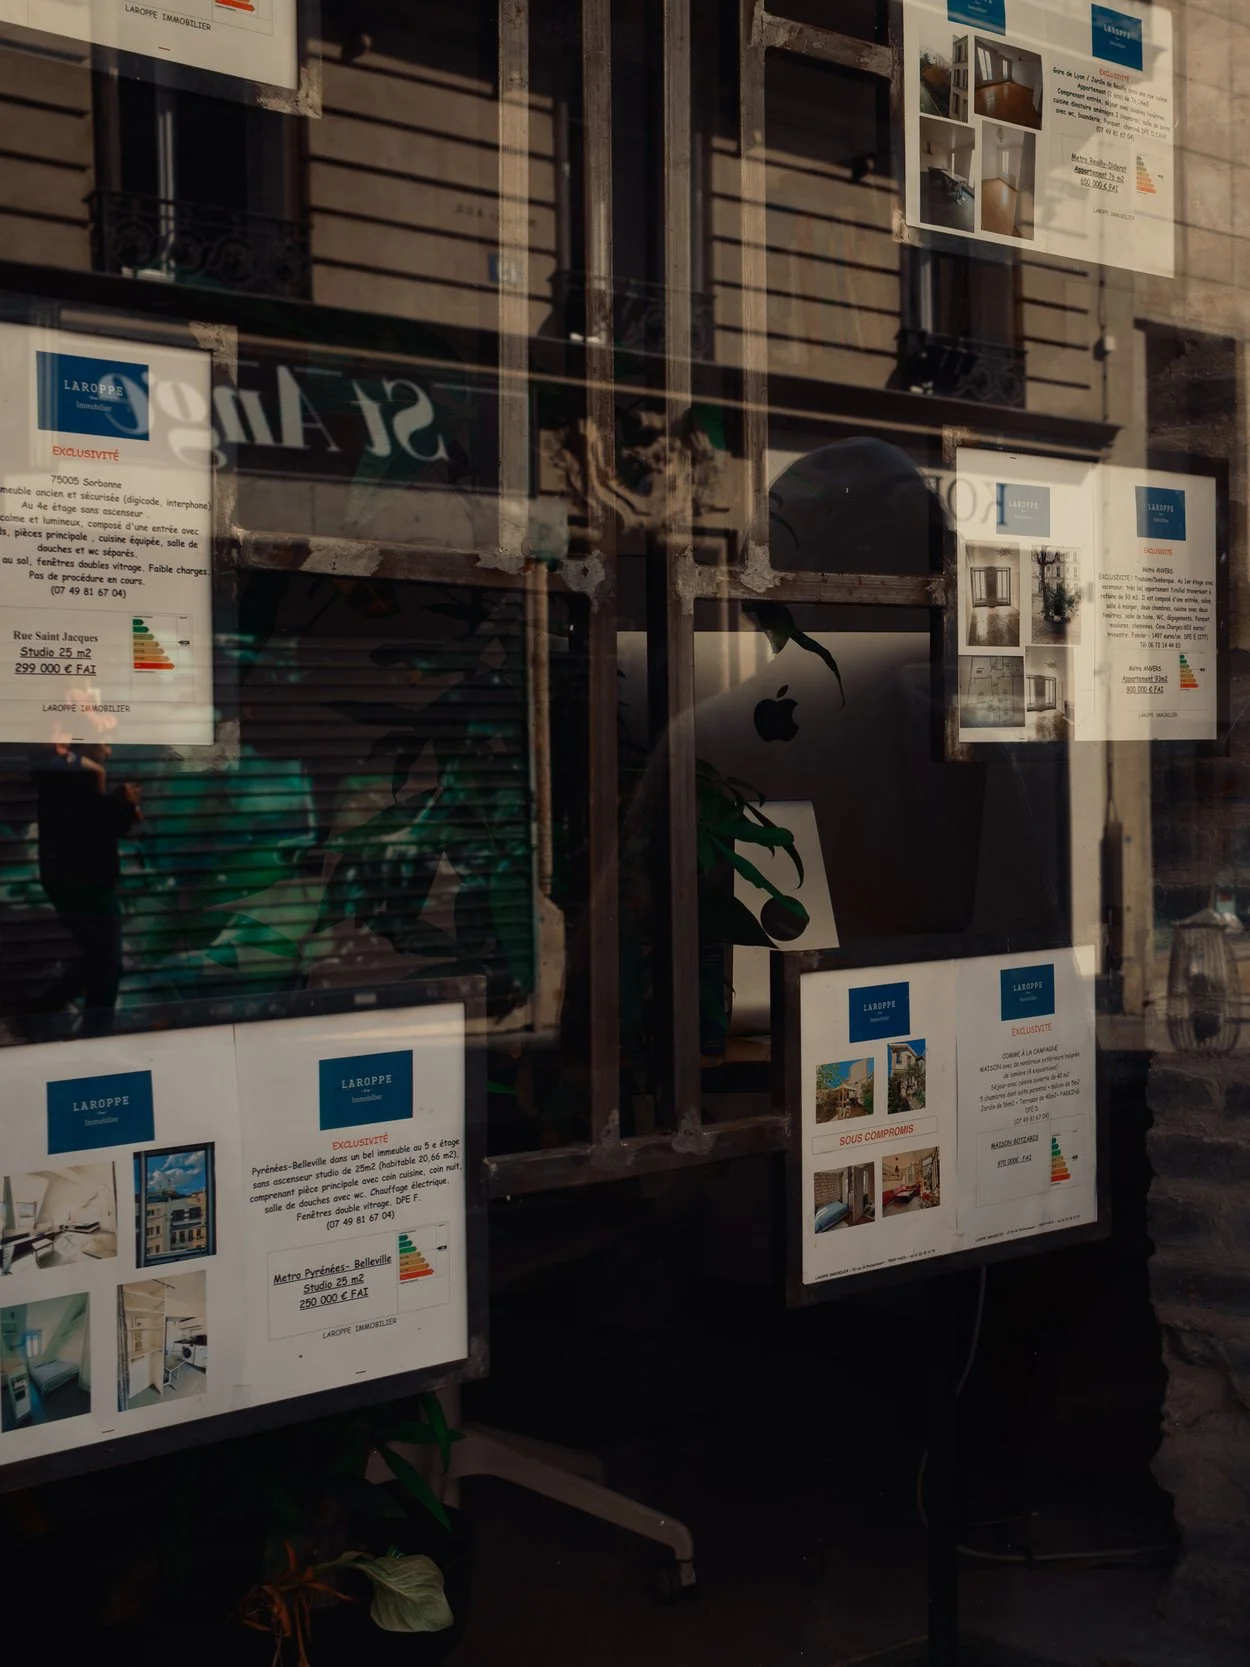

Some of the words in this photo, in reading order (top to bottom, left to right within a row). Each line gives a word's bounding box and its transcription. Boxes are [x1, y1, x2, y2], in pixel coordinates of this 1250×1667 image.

[124, 4, 158, 19] LAROPPE
[161, 13, 212, 31] IMMOBILIER
[1103, 24, 1131, 40] LAROPPE
[64, 379, 124, 397] LAROPPE
[75, 401, 113, 413] Immobilier
[52, 445, 119, 461] EXCLUSIVITÉ
[50, 474, 79, 485] 75005
[82, 477, 121, 488] Sorbonne
[21, 501, 33, 509] Au
[36, 501, 48, 510] 4e
[51, 502, 76, 514] étage
[102, 508, 143, 517] ascenseur
[35, 489, 63, 498] ancien
[80, 491, 120, 502] sécurisée
[122, 494, 162, 507] (digicode,
[166, 500, 211, 512] interphone)
[1147, 502, 1175, 514] LAROPPE
[0, 513, 25, 522] calme
[42, 515, 83, 528] lumineux,
[87, 520, 122, 530] composé
[151, 525, 178, 533] entrée
[14, 527, 42, 538] pièces
[45, 530, 87, 542] principale
[98, 534, 126, 543] cuisine
[129, 535, 162, 547] équipée,
[167, 538, 185, 547] salle
[188, 540, 197, 548] de
[37, 543, 72, 553] douches
[102, 547, 136, 558] séparés.
[16, 556, 32, 566] sol,
[36, 556, 74, 567] fenêtres
[78, 559, 109, 569] doubles
[112, 562, 144, 573] vitrage.
[176, 566, 211, 578] charges.
[28, 570, 44, 579] Pas
[47, 571, 58, 580] de
[61, 572, 104, 583] procédure
[50, 585, 65, 595] (07
[68, 586, 80, 595] 49
[83, 587, 93, 595] 81
[97, 588, 108, 596] 67
[111, 588, 126, 599] 04)
[13, 630, 32, 640] Rue
[35, 631, 59, 640] Saint
[61, 632, 98, 644] Jacques
[20, 646, 54, 657] Studio
[58, 647, 73, 658] 25
[76, 647, 91, 659] m2
[15, 662, 36, 673] 299
[40, 663, 60, 673] 000
[64, 664, 72, 673] €
[76, 663, 96, 674] FAI
[42, 704, 76, 712] LAROPPE
[80, 704, 130, 712] IMMOBILIER
[1013, 981, 1043, 992] LAROPPE
[863, 999, 897, 1012] LAROPPE
[341, 1074, 392, 1089] LAROPPE
[72, 1095, 130, 1113] LAROPPE
[351, 1093, 383, 1104] Immobilier
[332, 1132, 388, 1150] EXCLUSIVITÉ
[839, 1133, 863, 1146] SOUS
[864, 1124, 913, 1141] COMPROMIS
[251, 1157, 327, 1177] Pyrénées-Belleville
[329, 1155, 347, 1164] dans
[362, 1149, 374, 1159] bel
[377, 1144, 410, 1156] immeuble
[424, 1141, 429, 1149] 5
[439, 1138, 459, 1148] étage
[252, 1180, 270, 1189] sans
[272, 1174, 312, 1185] ascenseur
[315, 1168, 339, 1179] studio
[341, 1166, 351, 1175] de
[355, 1162, 375, 1172] 25m2
[378, 1156, 416, 1170] (habitable
[249, 1188, 295, 1202] comprenant
[298, 1185, 318, 1197] pièce
[321, 1178, 358, 1193] principale
[361, 1176, 378, 1184] avec
[381, 1172, 396, 1181] coin
[398, 1168, 425, 1178] cuisine,
[429, 1165, 443, 1174] coin
[445, 1162, 462, 1171] nuit,
[264, 1203, 282, 1213] salle
[285, 1201, 295, 1210] de
[298, 1196, 330, 1207] douches
[333, 1194, 350, 1202] avec
[369, 1184, 408, 1196] Chauffage
[411, 1178, 449, 1189] électrique.
[296, 1209, 332, 1221] Fenêtres
[334, 1203, 360, 1214] double
[362, 1200, 392, 1210] vitrage.
[395, 1194, 410, 1204] DPE
[413, 1193, 420, 1201] F.
[326, 1219, 340, 1230] (07
[342, 1217, 353, 1225] 49
[356, 1215, 365, 1224] 81
[368, 1212, 379, 1222] 67
[381, 1210, 394, 1219] 04)
[273, 1272, 301, 1285] Metro
[304, 1263, 350, 1280] Pyrénées-
[353, 1254, 392, 1270] Belleville
[303, 1280, 332, 1293] Studio
[336, 1276, 347, 1286] 25
[351, 1273, 364, 1284] m2
[299, 1296, 316, 1308] 250
[320, 1292, 338, 1304] 000
[340, 1291, 347, 1300] €
[350, 1287, 368, 1298] FAI
[322, 1326, 351, 1339] LAROPPE
[355, 1317, 397, 1332] IMMOBILIER
